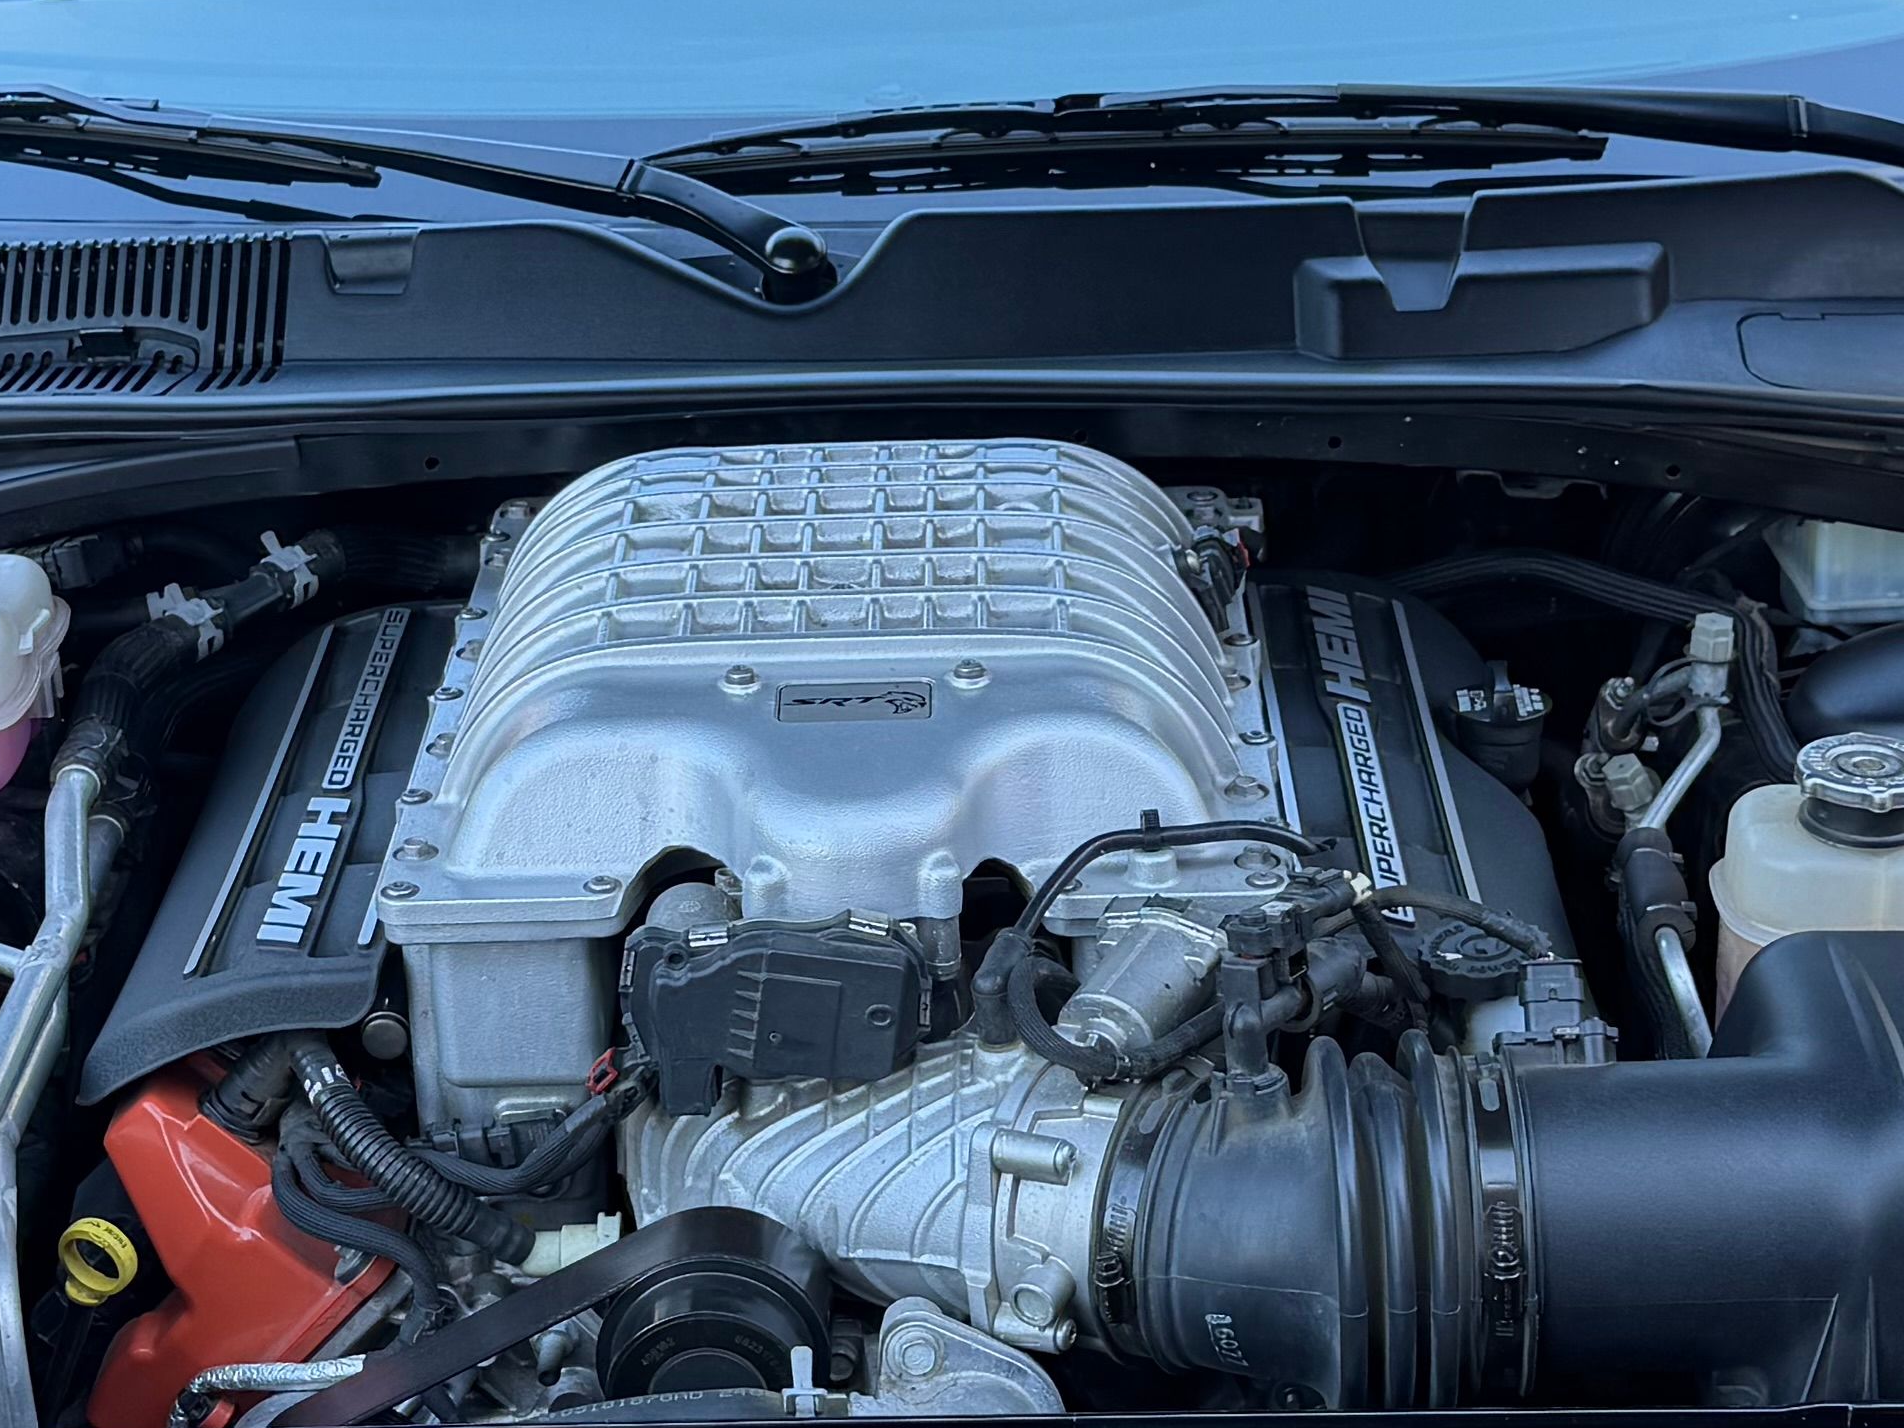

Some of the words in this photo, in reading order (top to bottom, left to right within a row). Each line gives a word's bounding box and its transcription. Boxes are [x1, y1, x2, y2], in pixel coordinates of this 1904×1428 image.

[325, 608, 409, 788] SUPERCHARGED
[783, 692, 885, 708] SRT
[1306, 585, 1371, 703] HEMI
[256, 796, 352, 946] HEMI
